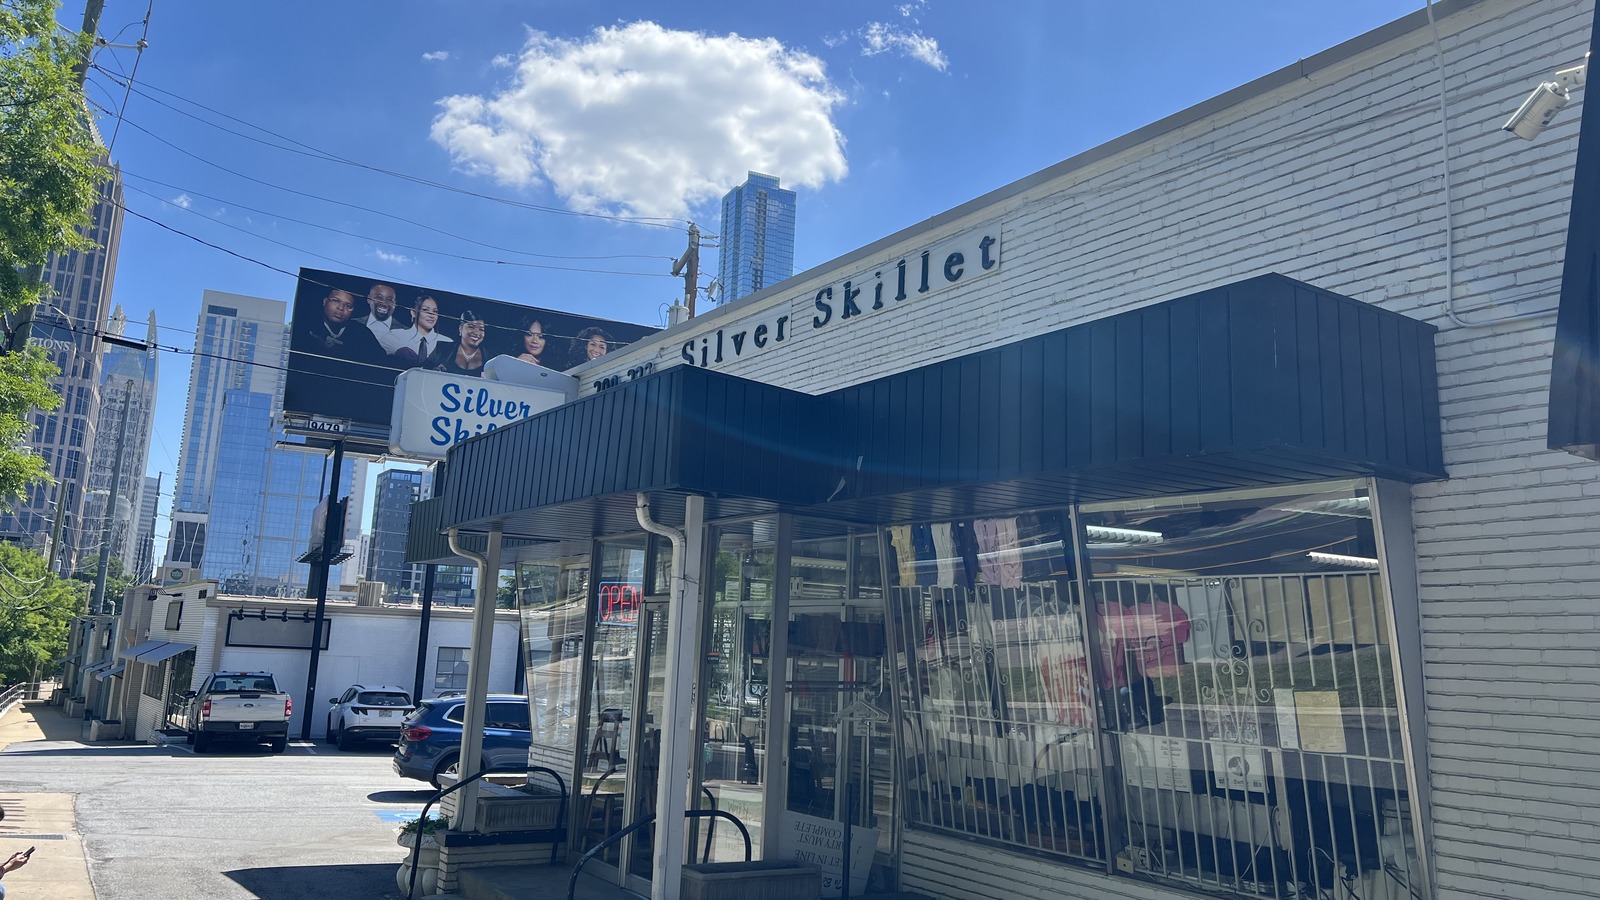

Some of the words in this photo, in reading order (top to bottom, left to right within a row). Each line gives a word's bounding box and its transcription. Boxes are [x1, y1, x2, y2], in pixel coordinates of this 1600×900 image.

[681, 314, 789, 367] Silver
[813, 235, 996, 328] Skillet
[27, 337, 72, 351] GIONS
[440, 383, 531, 420] Silver
[600, 585, 642, 622] OPEN
[794, 821, 842, 839] COMPLETE
[797, 833, 824, 846] MUST
[824, 838, 843, 850] RTY
[794, 849, 815, 862] LINE
